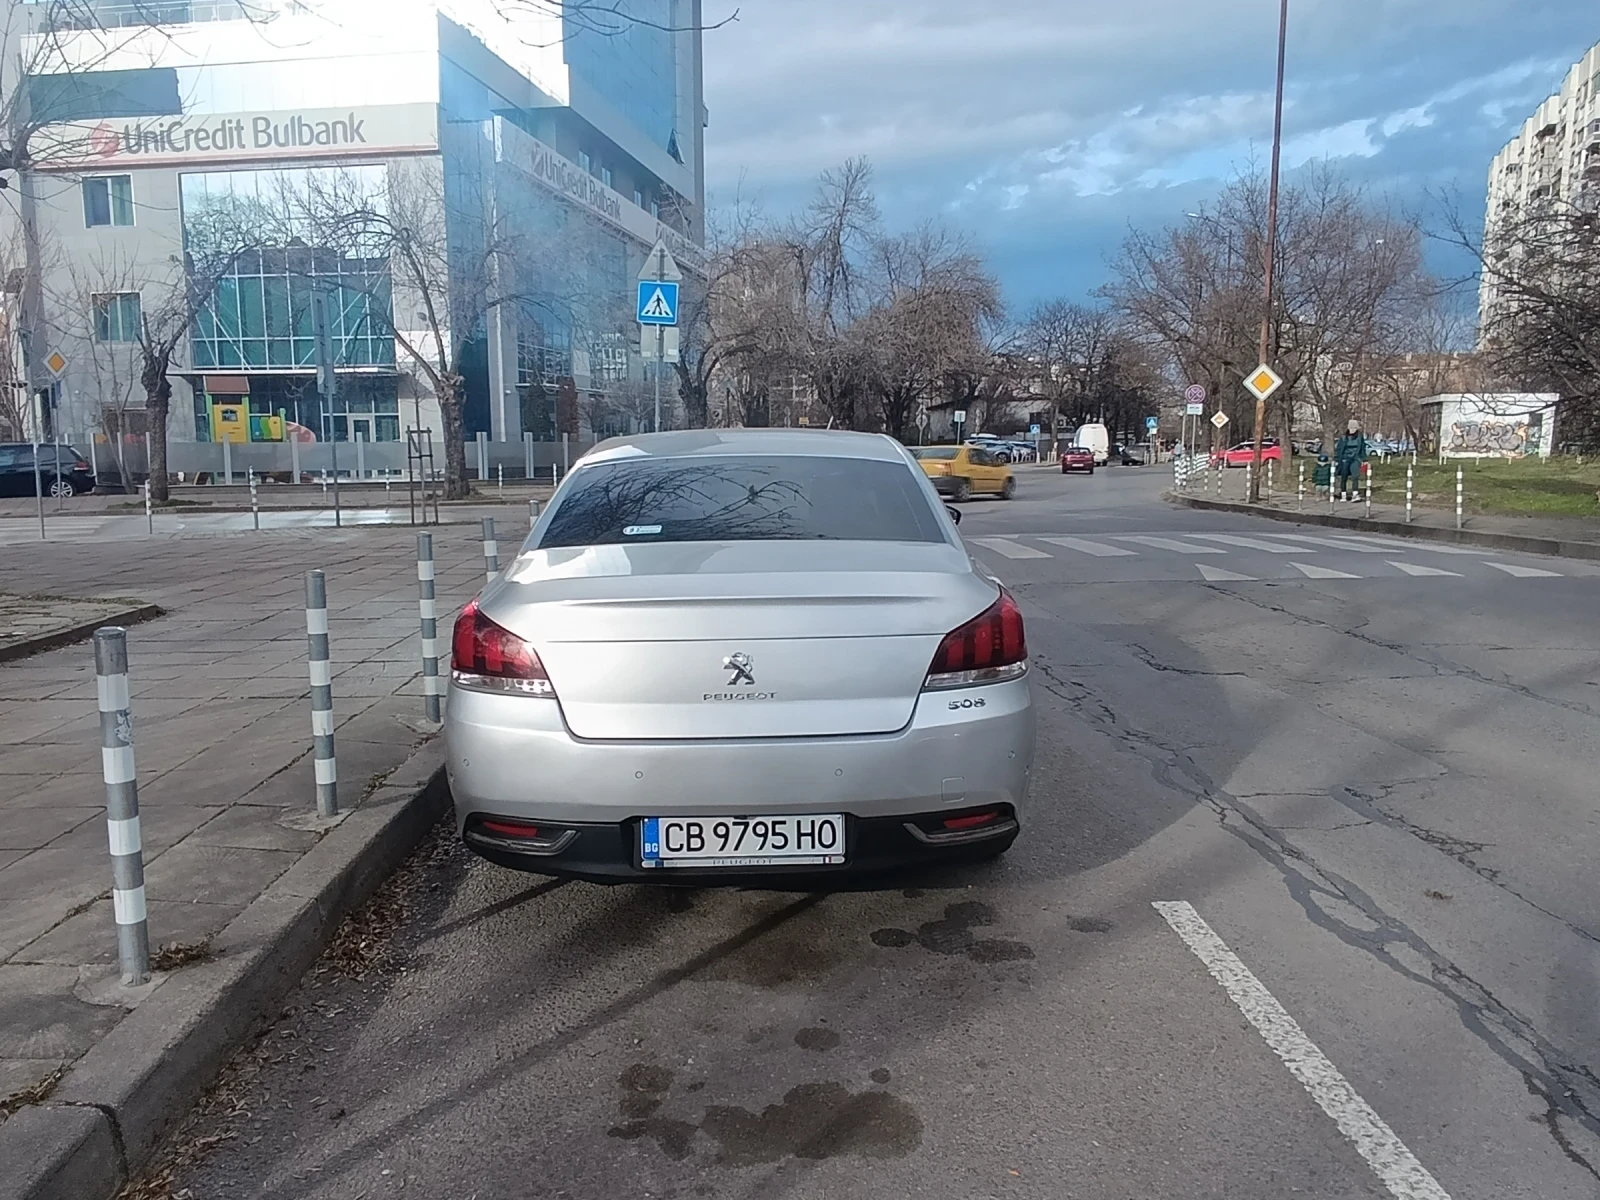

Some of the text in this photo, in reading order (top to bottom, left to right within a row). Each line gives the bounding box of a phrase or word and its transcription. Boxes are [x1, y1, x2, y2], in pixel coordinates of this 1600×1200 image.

[124, 112, 367, 155] UniCredit Bulbank
[545, 151, 590, 200] UniCredit
[703, 691, 778, 701] PEUGEOT
[948, 697, 987, 710] 508
[665, 822, 706, 852] CB
[712, 820, 789, 852] 9795
[644, 842, 659, 853] BG
